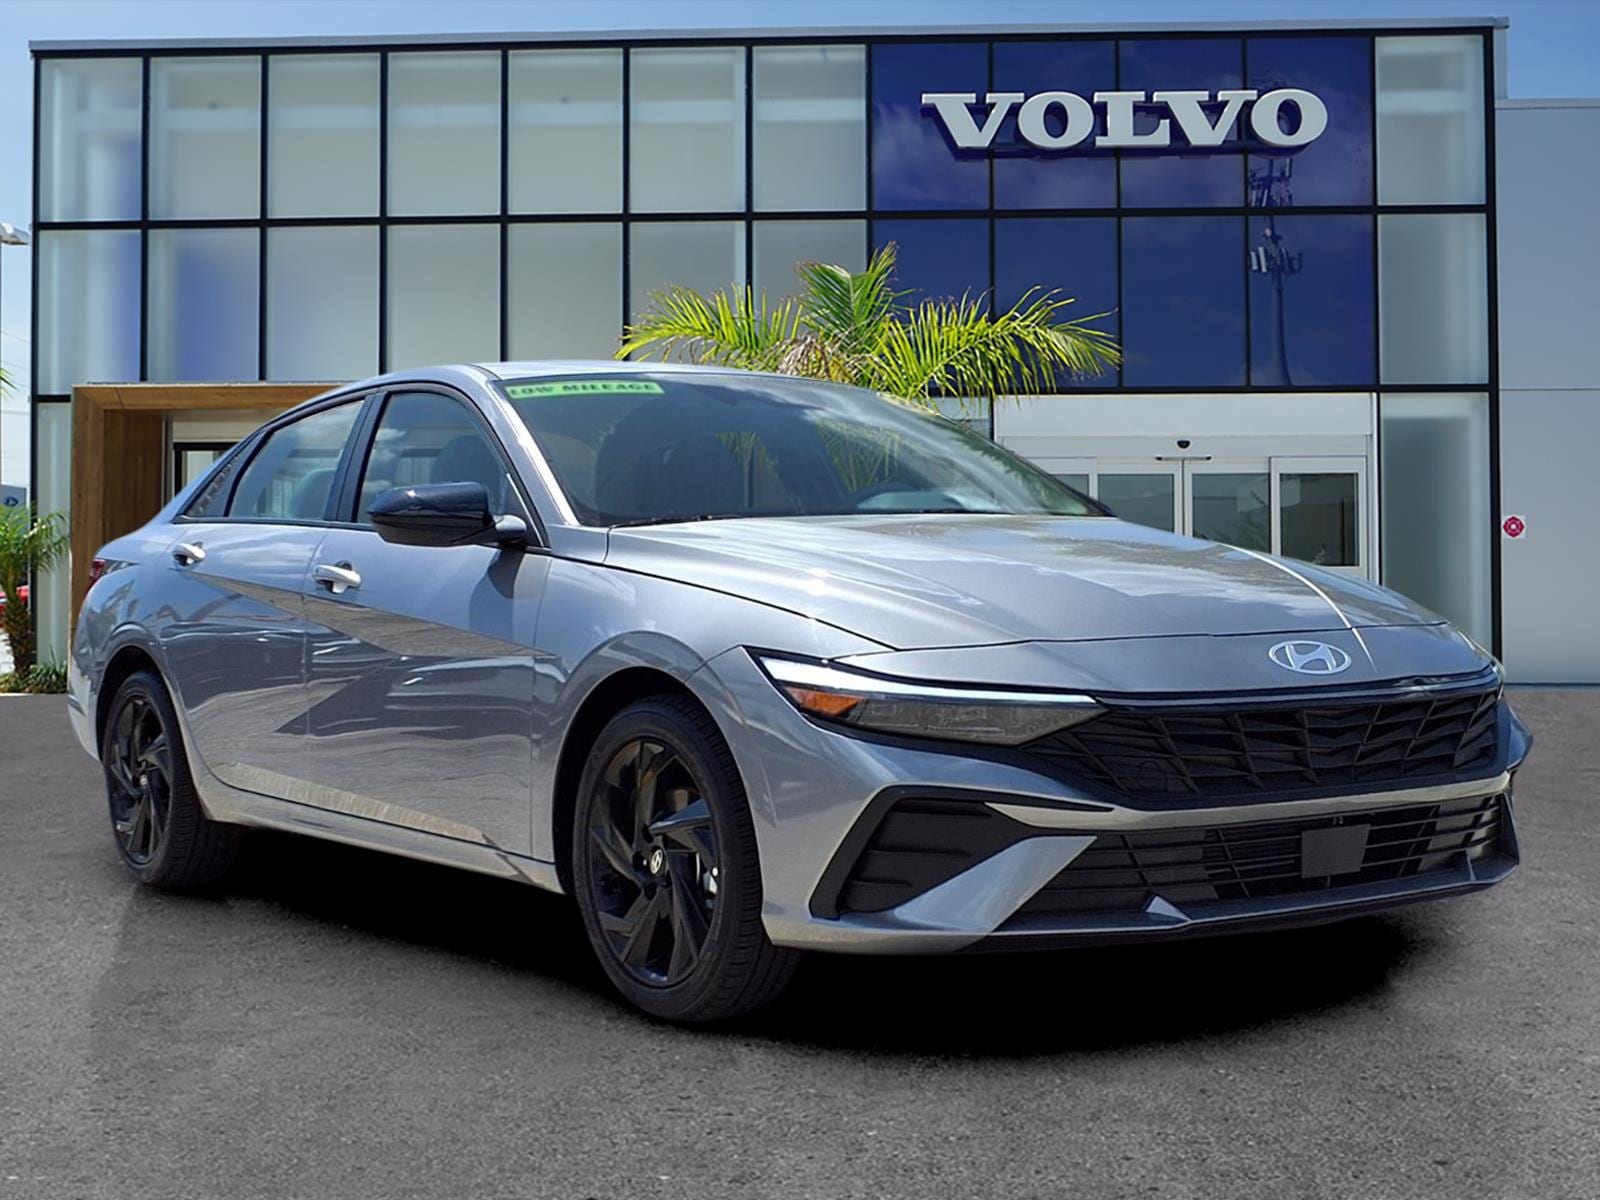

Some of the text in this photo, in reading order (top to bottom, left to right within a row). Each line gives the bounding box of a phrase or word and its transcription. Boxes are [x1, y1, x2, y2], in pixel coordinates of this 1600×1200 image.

[921, 88, 1328, 149] VOLVO
[509, 383, 657, 396] LOW MILEAGE
